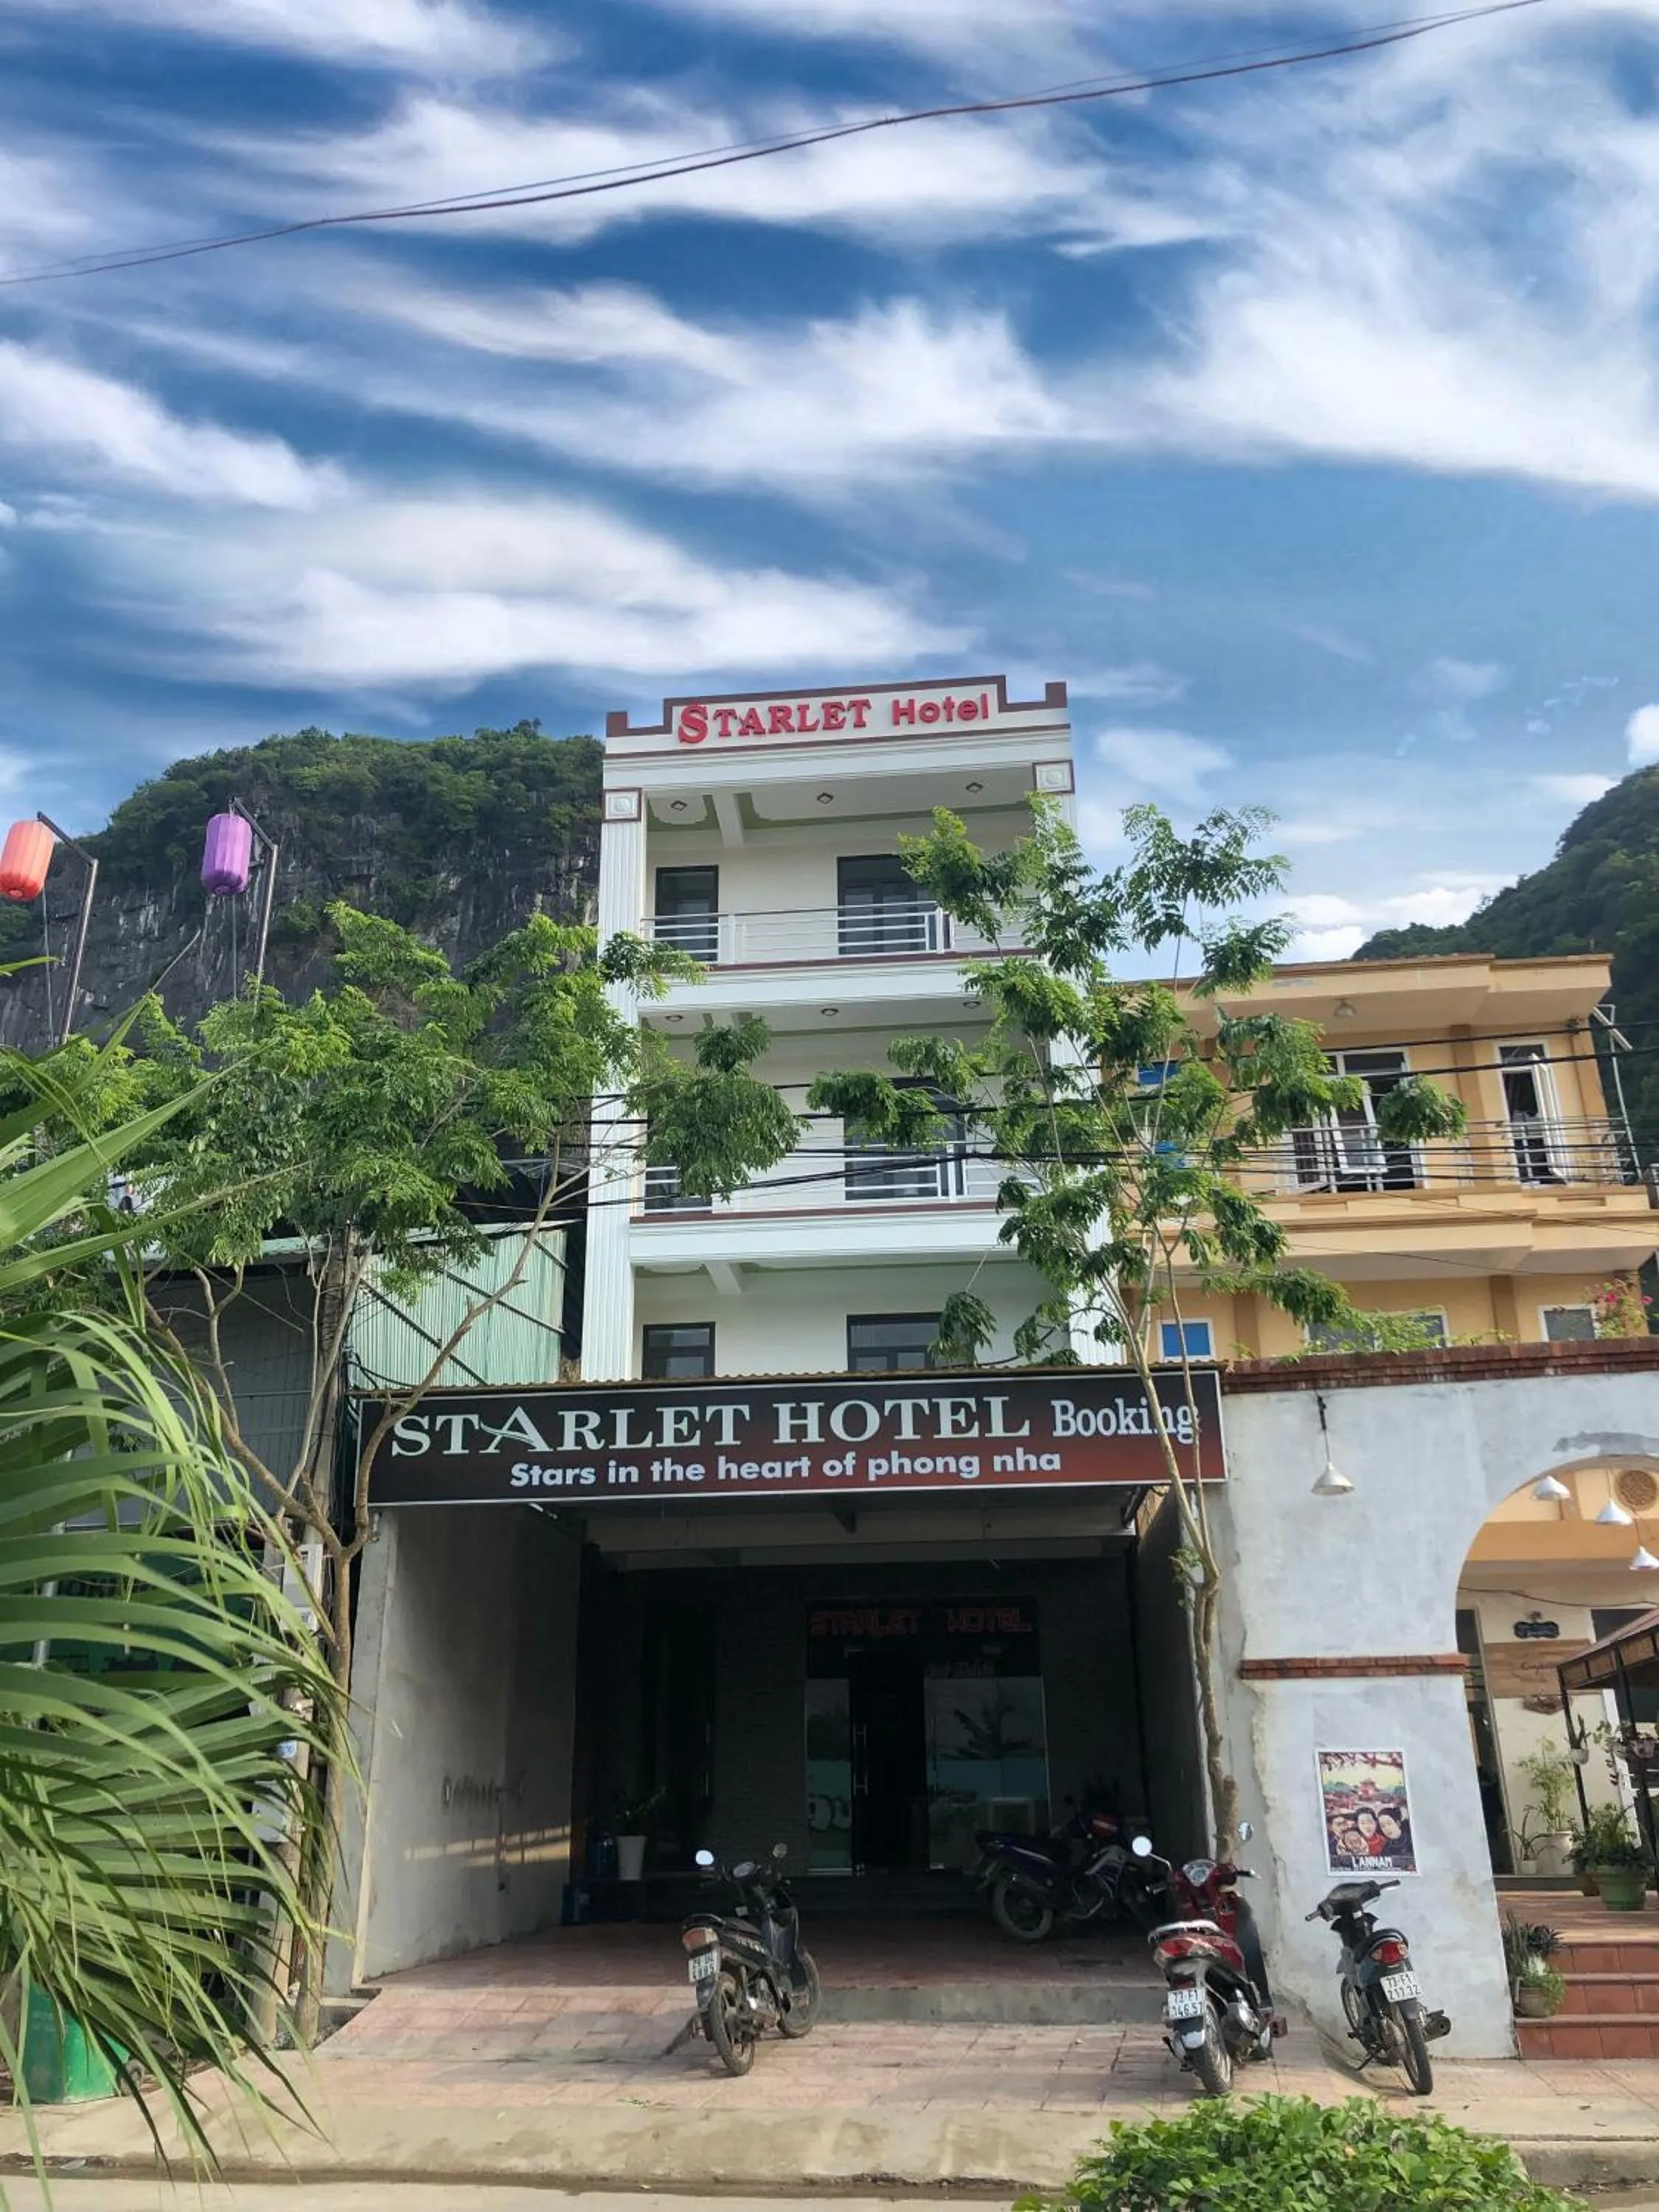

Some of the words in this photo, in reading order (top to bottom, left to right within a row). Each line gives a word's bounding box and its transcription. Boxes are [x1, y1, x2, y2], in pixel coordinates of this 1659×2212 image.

[678, 698, 872, 743] STARLET
[893, 693, 989, 726] Hotel
[391, 1405, 751, 1458] STARLET
[773, 1396, 1031, 1444] HOTEL
[1051, 1396, 1198, 1444] Booking
[509, 1458, 597, 1487] Stars
[608, 1460, 639, 1484] in
[650, 1456, 706, 1483] the
[717, 1455, 811, 1481] heart
[822, 1450, 857, 1478] of
[868, 1450, 981, 1481] phong
[993, 1447, 1062, 1472] nha
